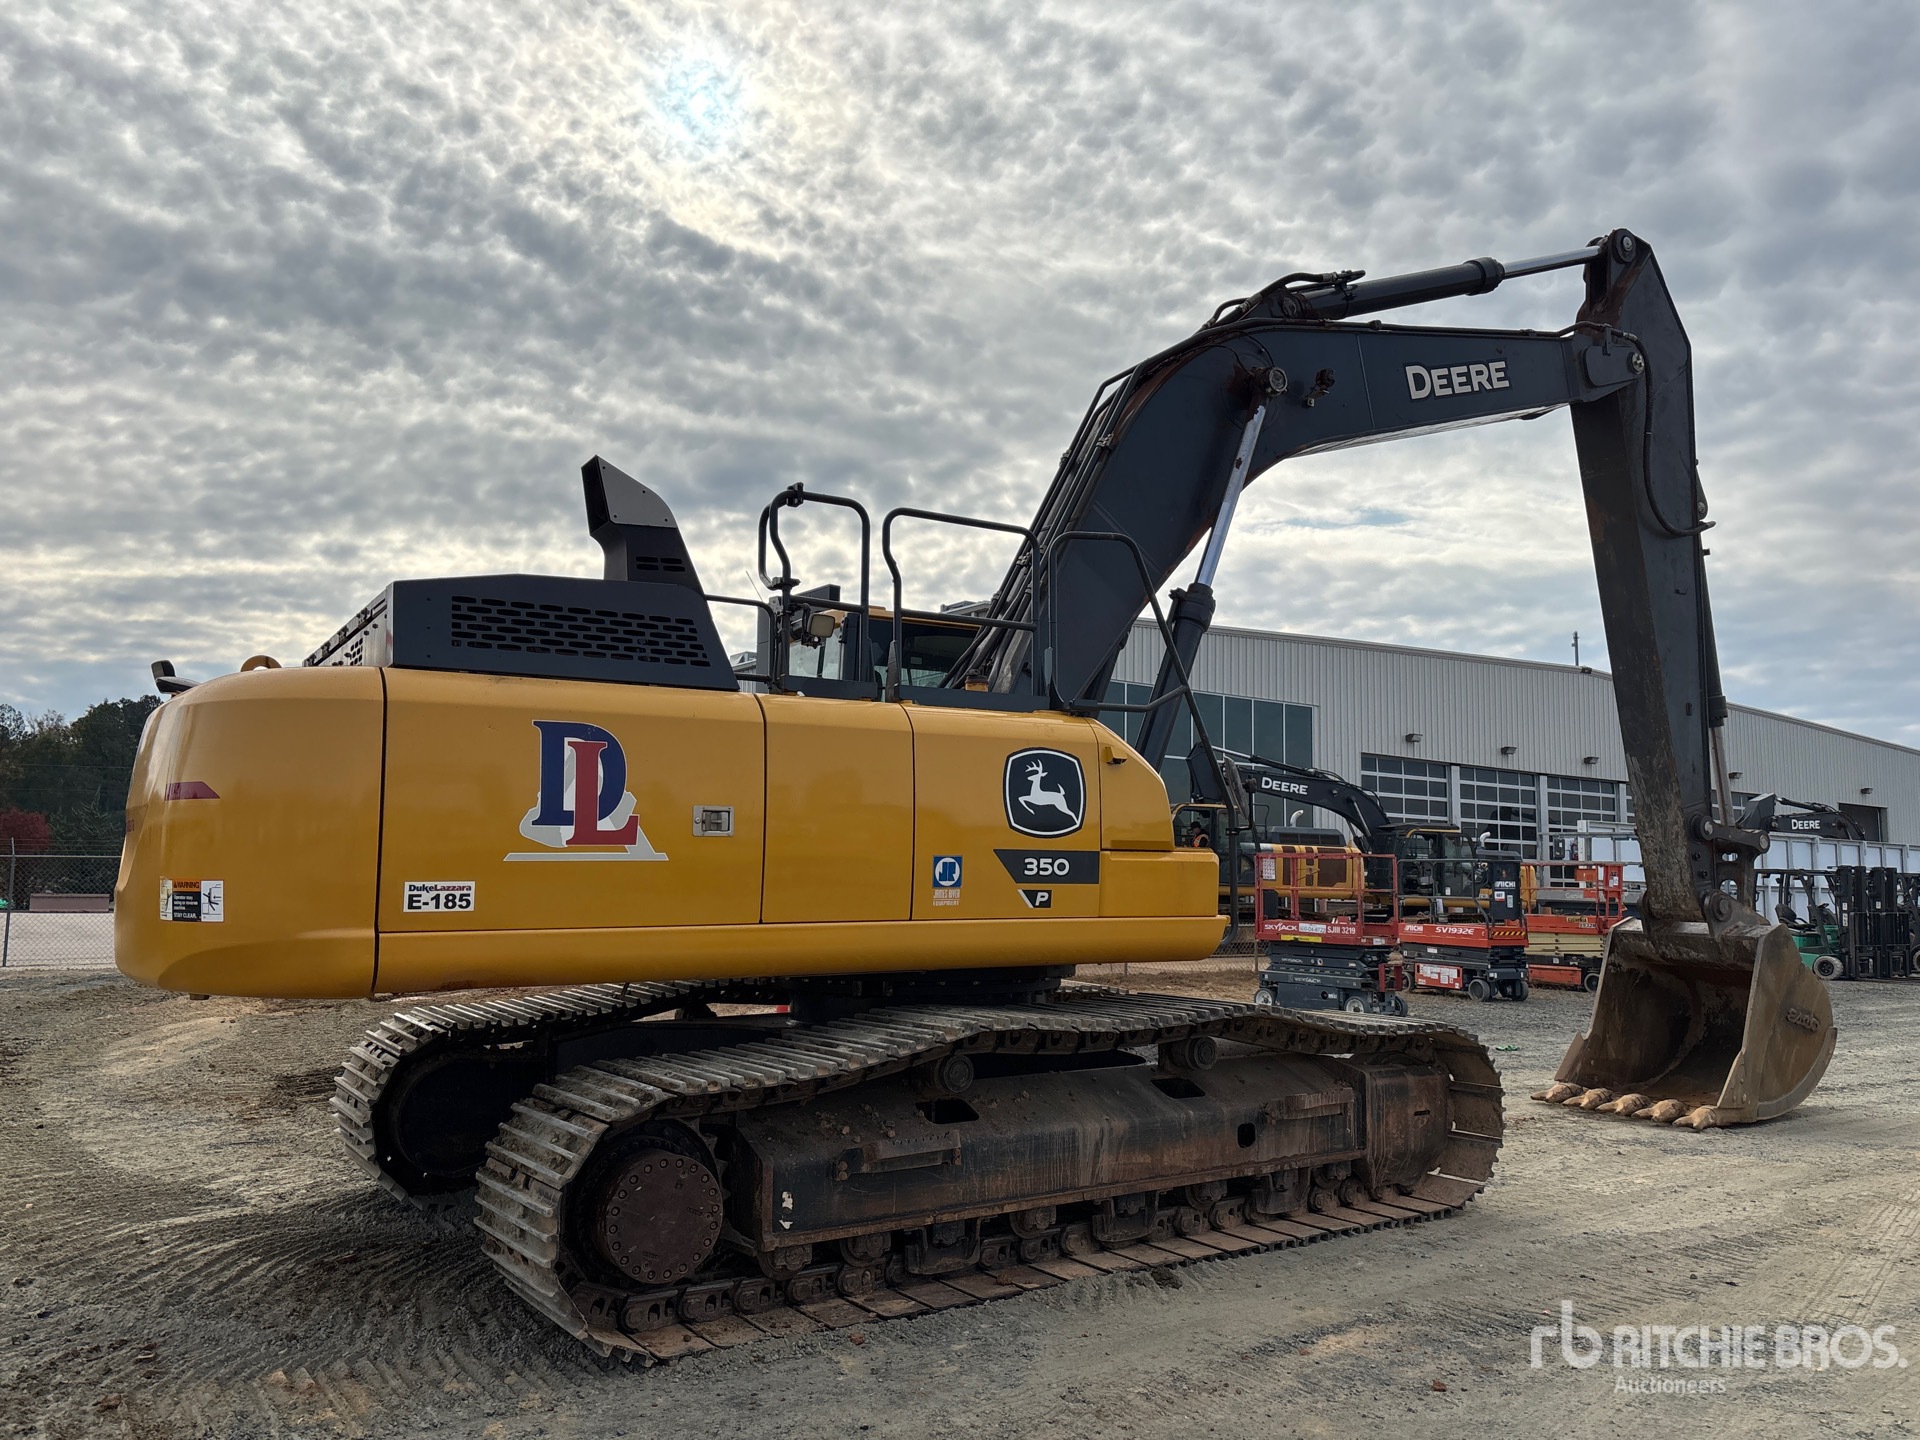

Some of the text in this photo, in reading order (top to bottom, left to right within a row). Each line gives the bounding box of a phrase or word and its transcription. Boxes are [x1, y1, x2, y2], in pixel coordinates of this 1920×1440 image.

[1405, 361, 1509, 399] DEERE
[1261, 776, 1308, 795] DEERE
[1791, 819, 1820, 830] DEERE
[1024, 858, 1070, 876] 350
[177, 881, 200, 889] WARNING
[408, 884, 472, 893] DukeLazzara
[407, 893, 471, 910] E-185
[1035, 892, 1049, 906] P
[1264, 922, 1298, 931] SKYJACK
[1342, 926, 1356, 935] 3219
[1435, 926, 1475, 935] SV1932E
